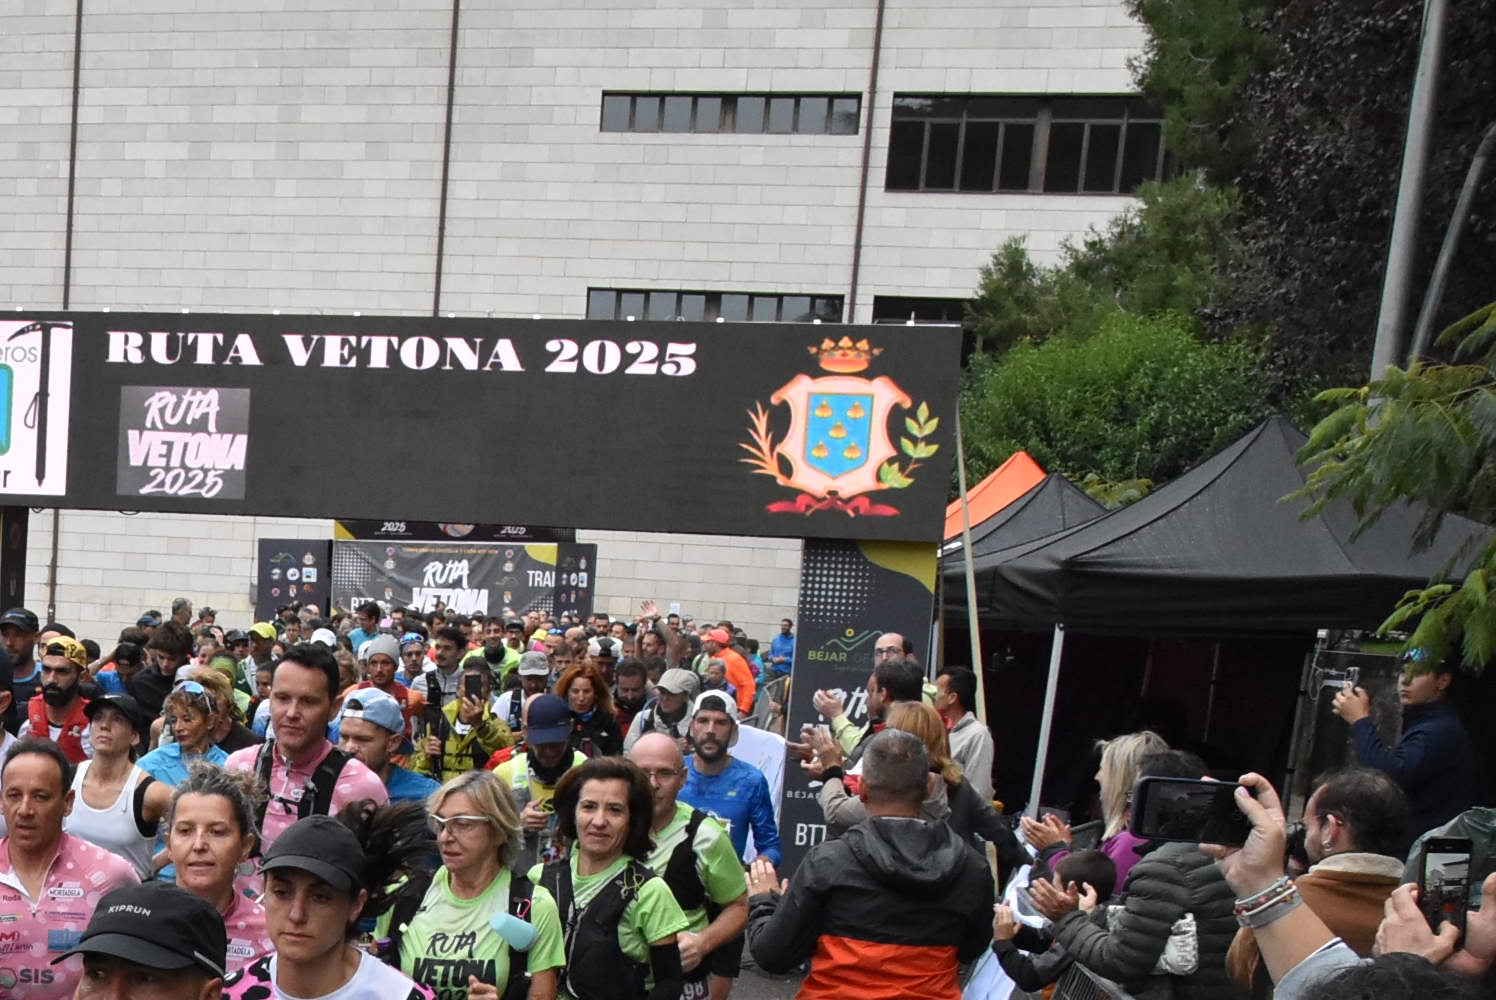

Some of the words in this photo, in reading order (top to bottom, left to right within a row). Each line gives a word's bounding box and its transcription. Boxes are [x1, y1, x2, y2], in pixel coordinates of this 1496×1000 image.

[104, 330, 264, 366] RUTA
[280, 334, 526, 372] VETONA
[542, 338, 699, 377] 2025
[143, 387, 221, 433] RUTA
[126, 428, 249, 471] VETONA
[138, 468, 226, 498] 2025
[423, 558, 470, 589] RUTA
[807, 646, 848, 662] BÉJAR
[107, 904, 152, 918] KIPRUN
[425, 930, 477, 959] RUTA
[19, 968, 54, 985] SIS
[412, 957, 497, 987] VETONA
